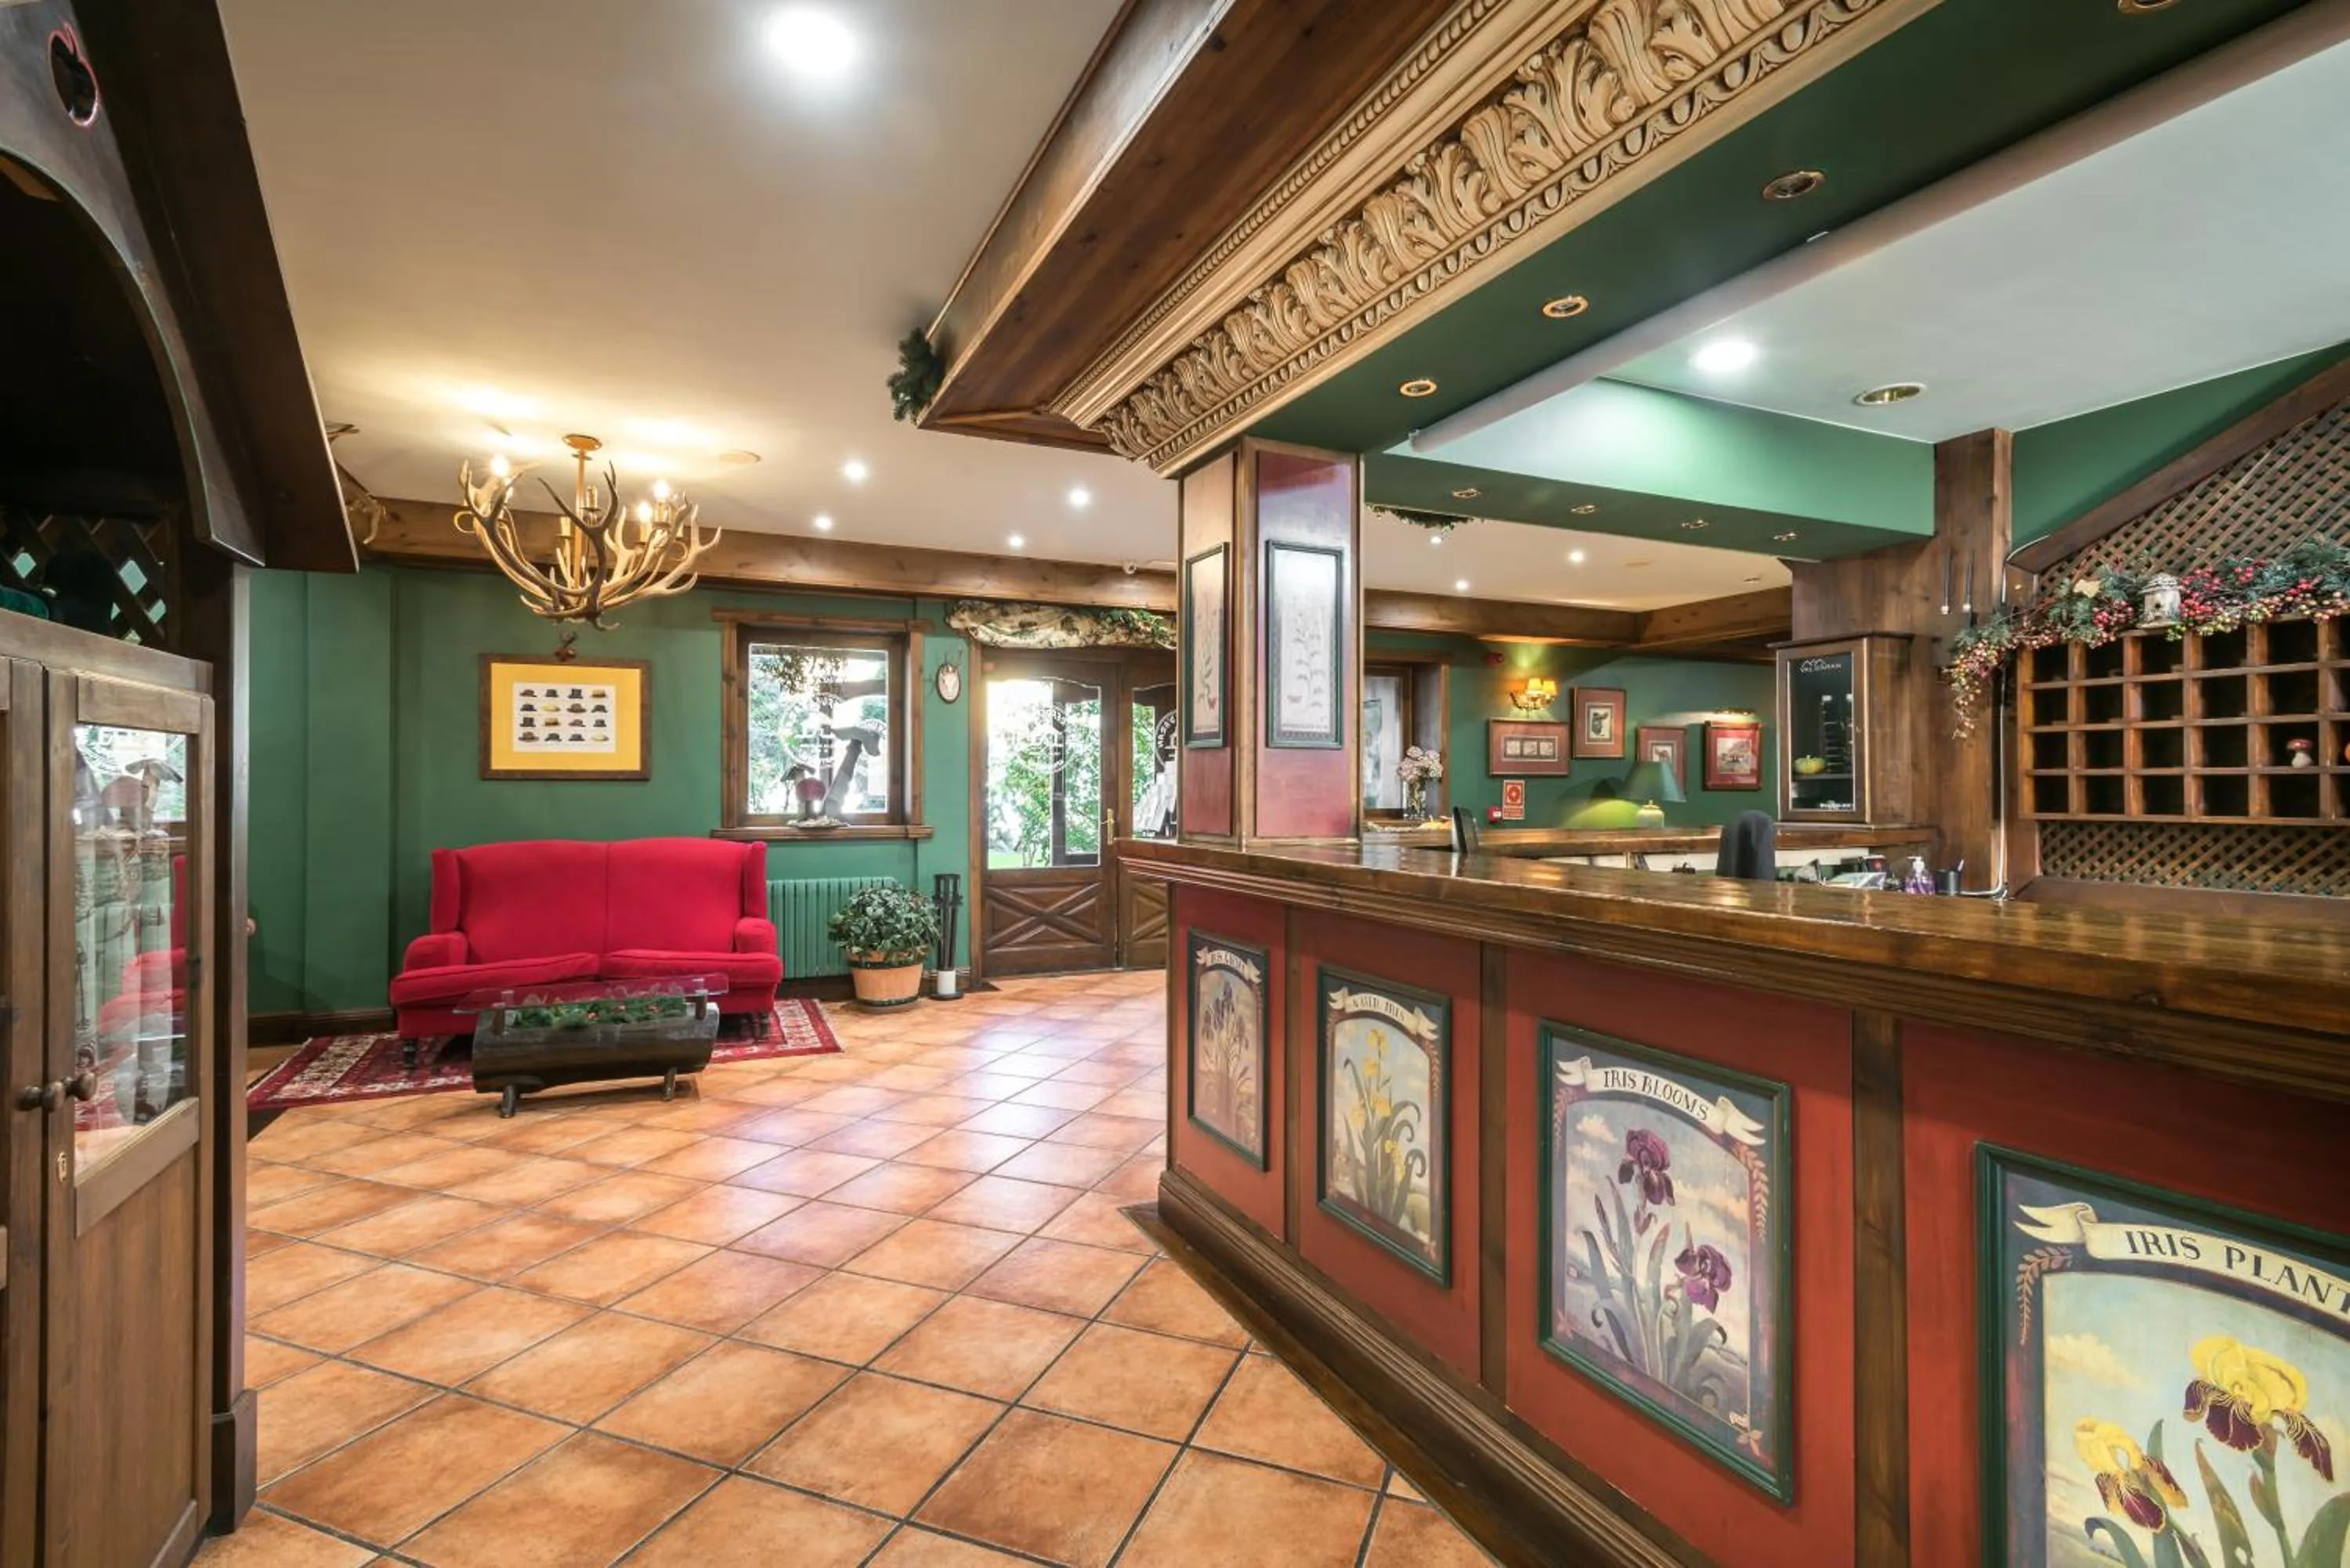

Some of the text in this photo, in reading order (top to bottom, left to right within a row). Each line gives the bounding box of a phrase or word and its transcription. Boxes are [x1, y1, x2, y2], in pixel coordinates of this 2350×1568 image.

[1604, 1070, 1709, 1121] IRIS BLOOMS
[2125, 1230, 2201, 1260] IRIS
